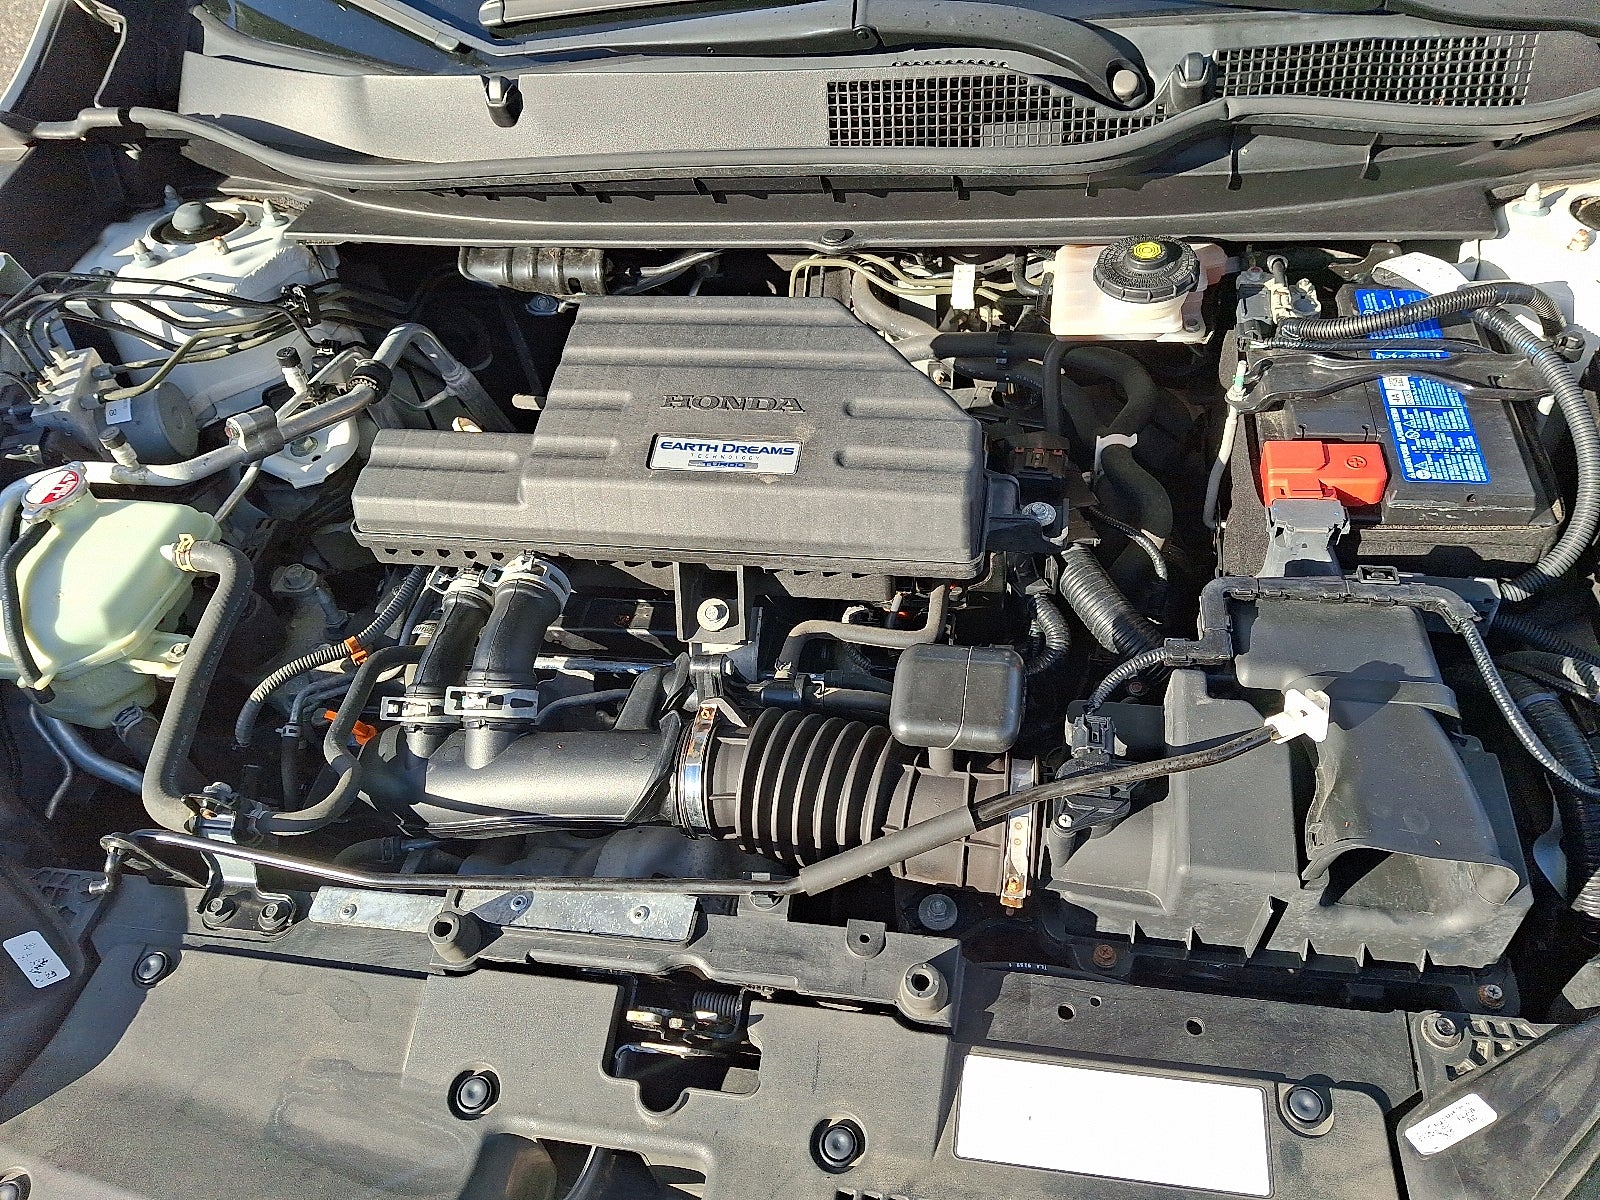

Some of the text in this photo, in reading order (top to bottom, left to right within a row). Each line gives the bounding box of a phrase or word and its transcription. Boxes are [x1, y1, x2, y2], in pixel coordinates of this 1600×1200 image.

[660, 394, 806, 413] HONDA
[660, 441, 795, 456] EARTH DREAMS
[690, 453, 761, 461] TECHNOLOGY
